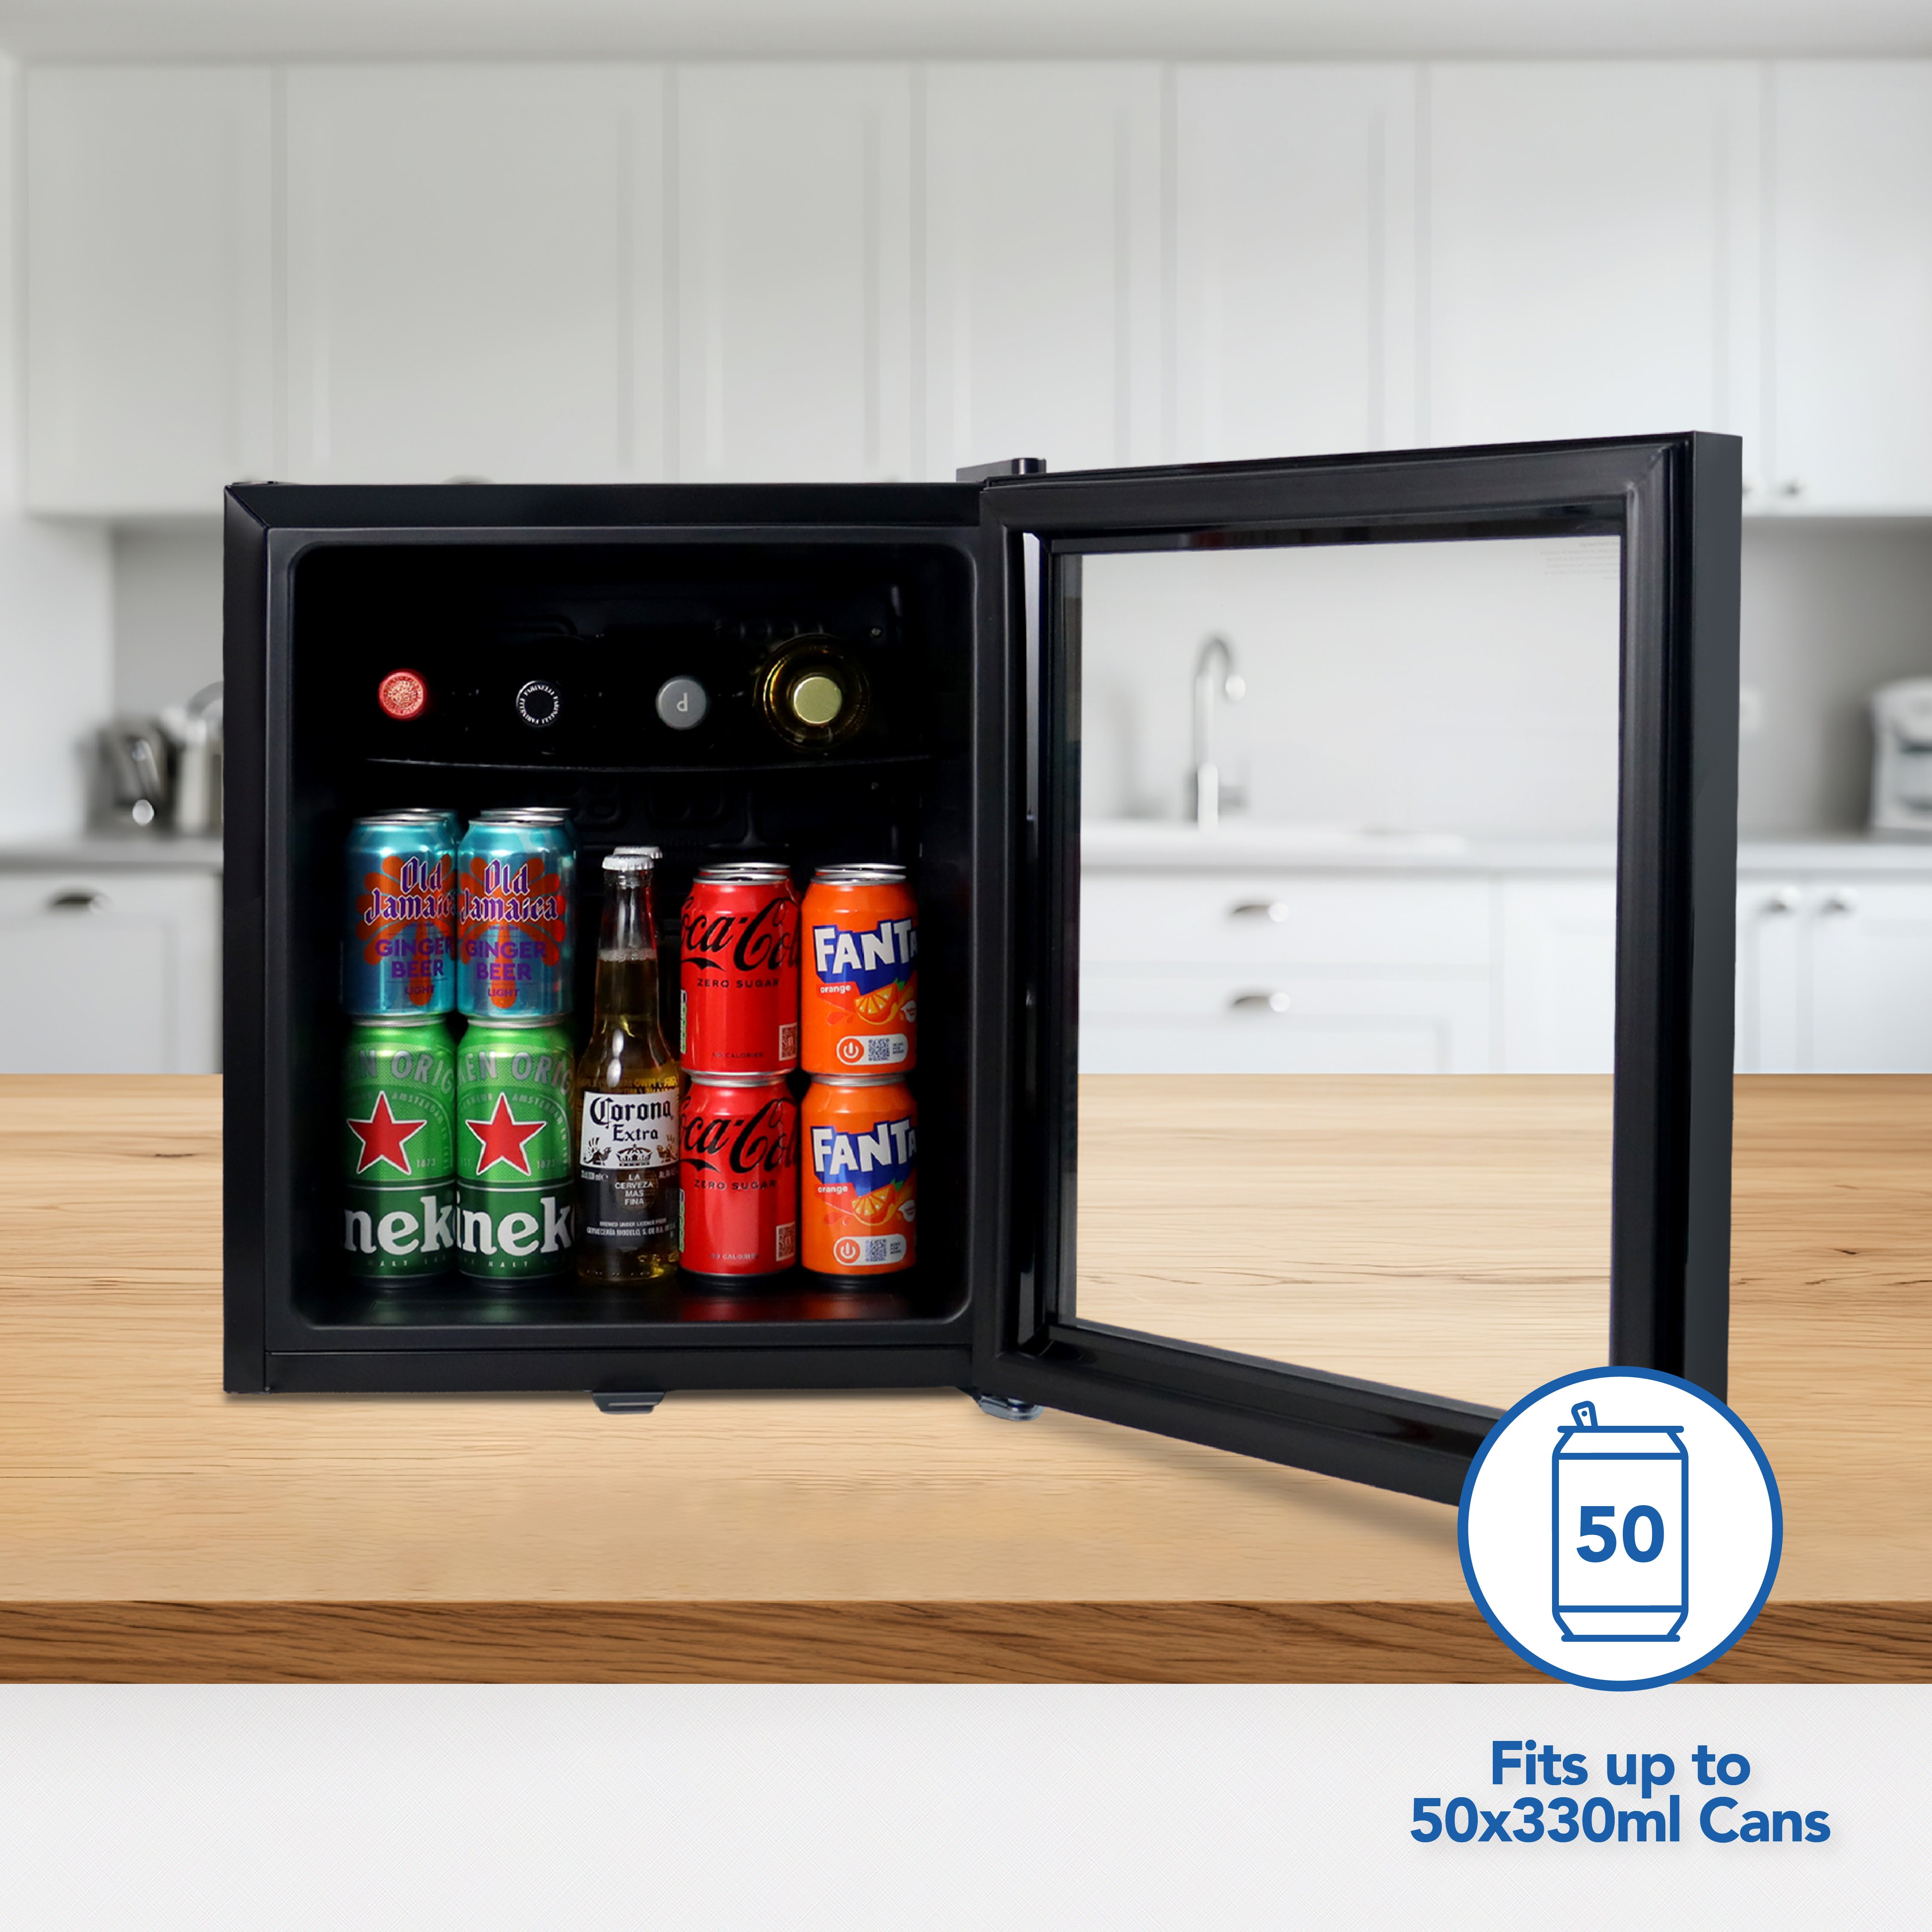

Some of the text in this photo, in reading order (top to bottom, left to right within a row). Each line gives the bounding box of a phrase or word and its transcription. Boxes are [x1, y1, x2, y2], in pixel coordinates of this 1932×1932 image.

[400, 856, 443, 894] Old
[484, 859, 530, 896] Old
[364, 887, 456, 926] Jamaic
[461, 888, 559, 925] Jamaica
[466, 940, 546, 959] GINGER
[392, 959, 444, 978] BEER
[477, 963, 532, 981] BEER
[405, 985, 435, 995] LIGHT
[697, 978, 779, 988] ZERO SUGAR
[820, 984, 851, 994] orange
[487, 988, 519, 997] LIGHT
[589, 1096, 673, 1129] Corona
[612, 1124, 659, 1142] Extra
[614, 1181, 654, 1190] CERVEZA
[694, 1179, 777, 1190] ZERO SUGAR
[818, 1185, 848, 1194] orange
